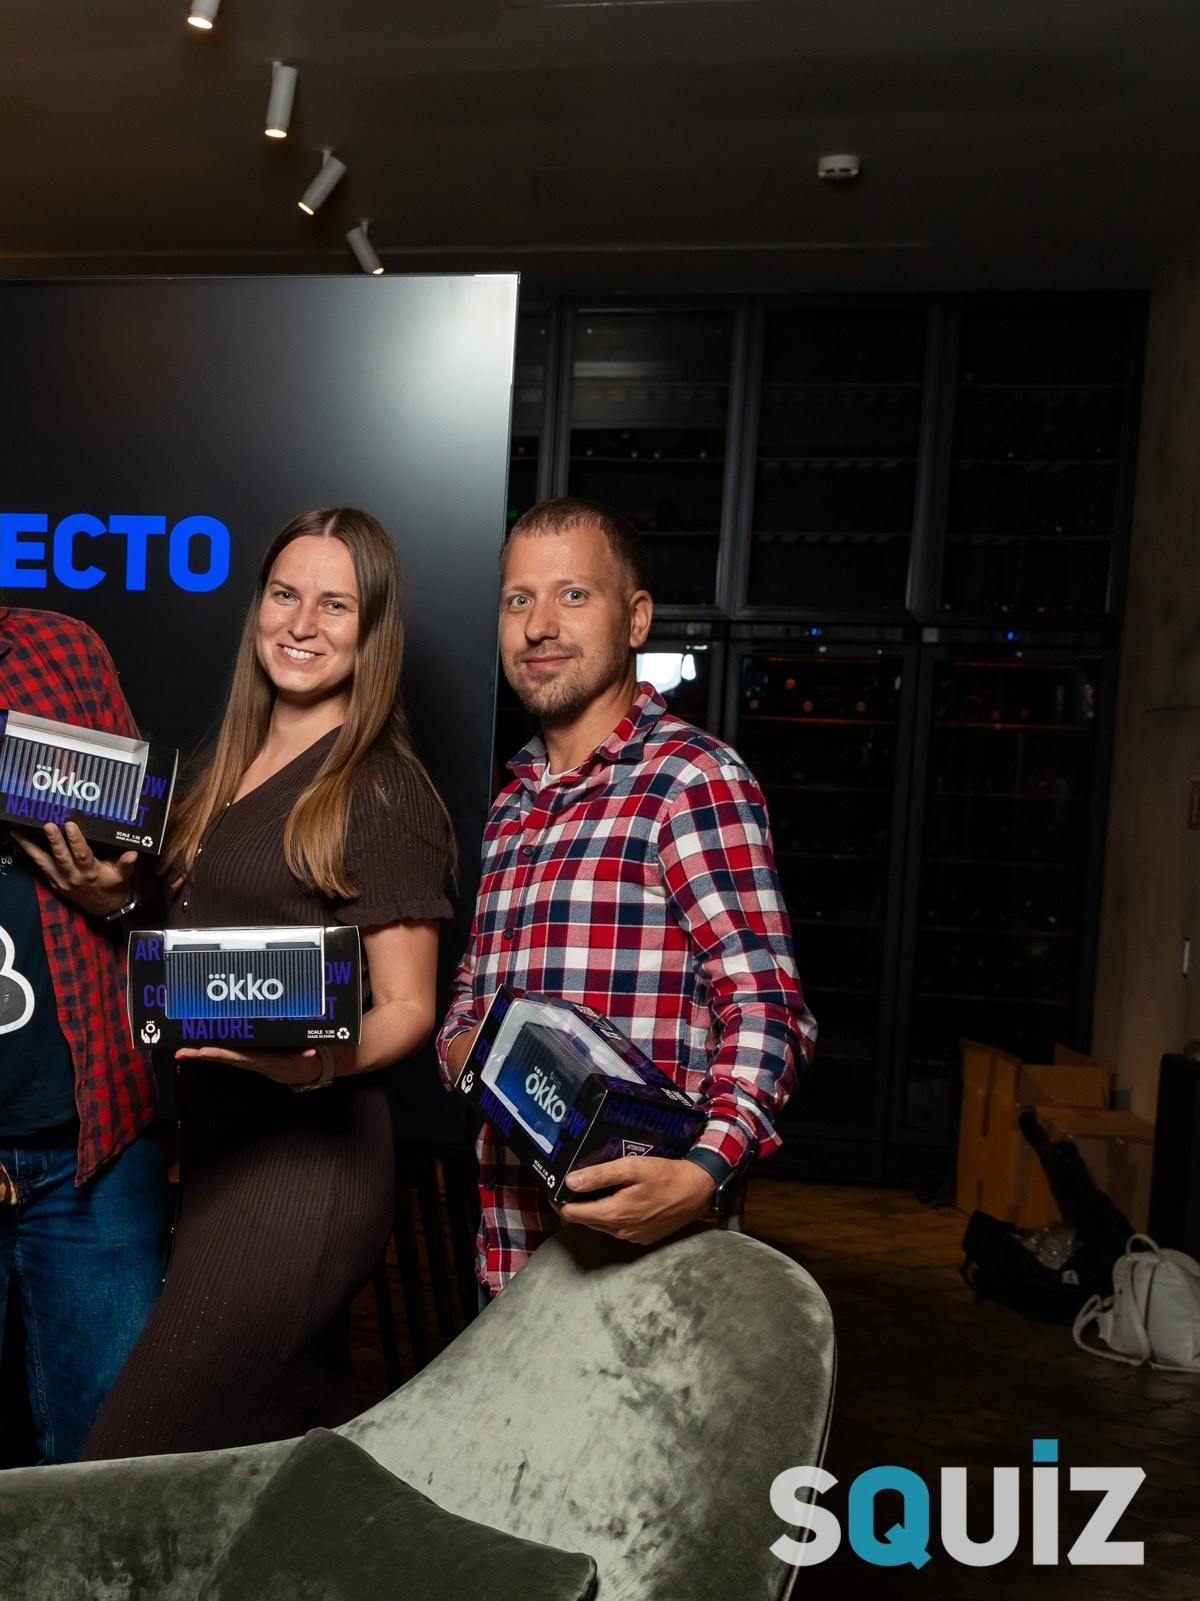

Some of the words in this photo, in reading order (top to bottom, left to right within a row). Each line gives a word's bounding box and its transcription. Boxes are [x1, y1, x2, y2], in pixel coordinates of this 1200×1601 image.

[32, 764, 101, 802] ökko
[206, 972, 285, 1002] ökko
[181, 1018, 255, 1040] NATURE
[524, 1065, 567, 1123] ökko
[603, 1098, 697, 1139] CARTOONS
